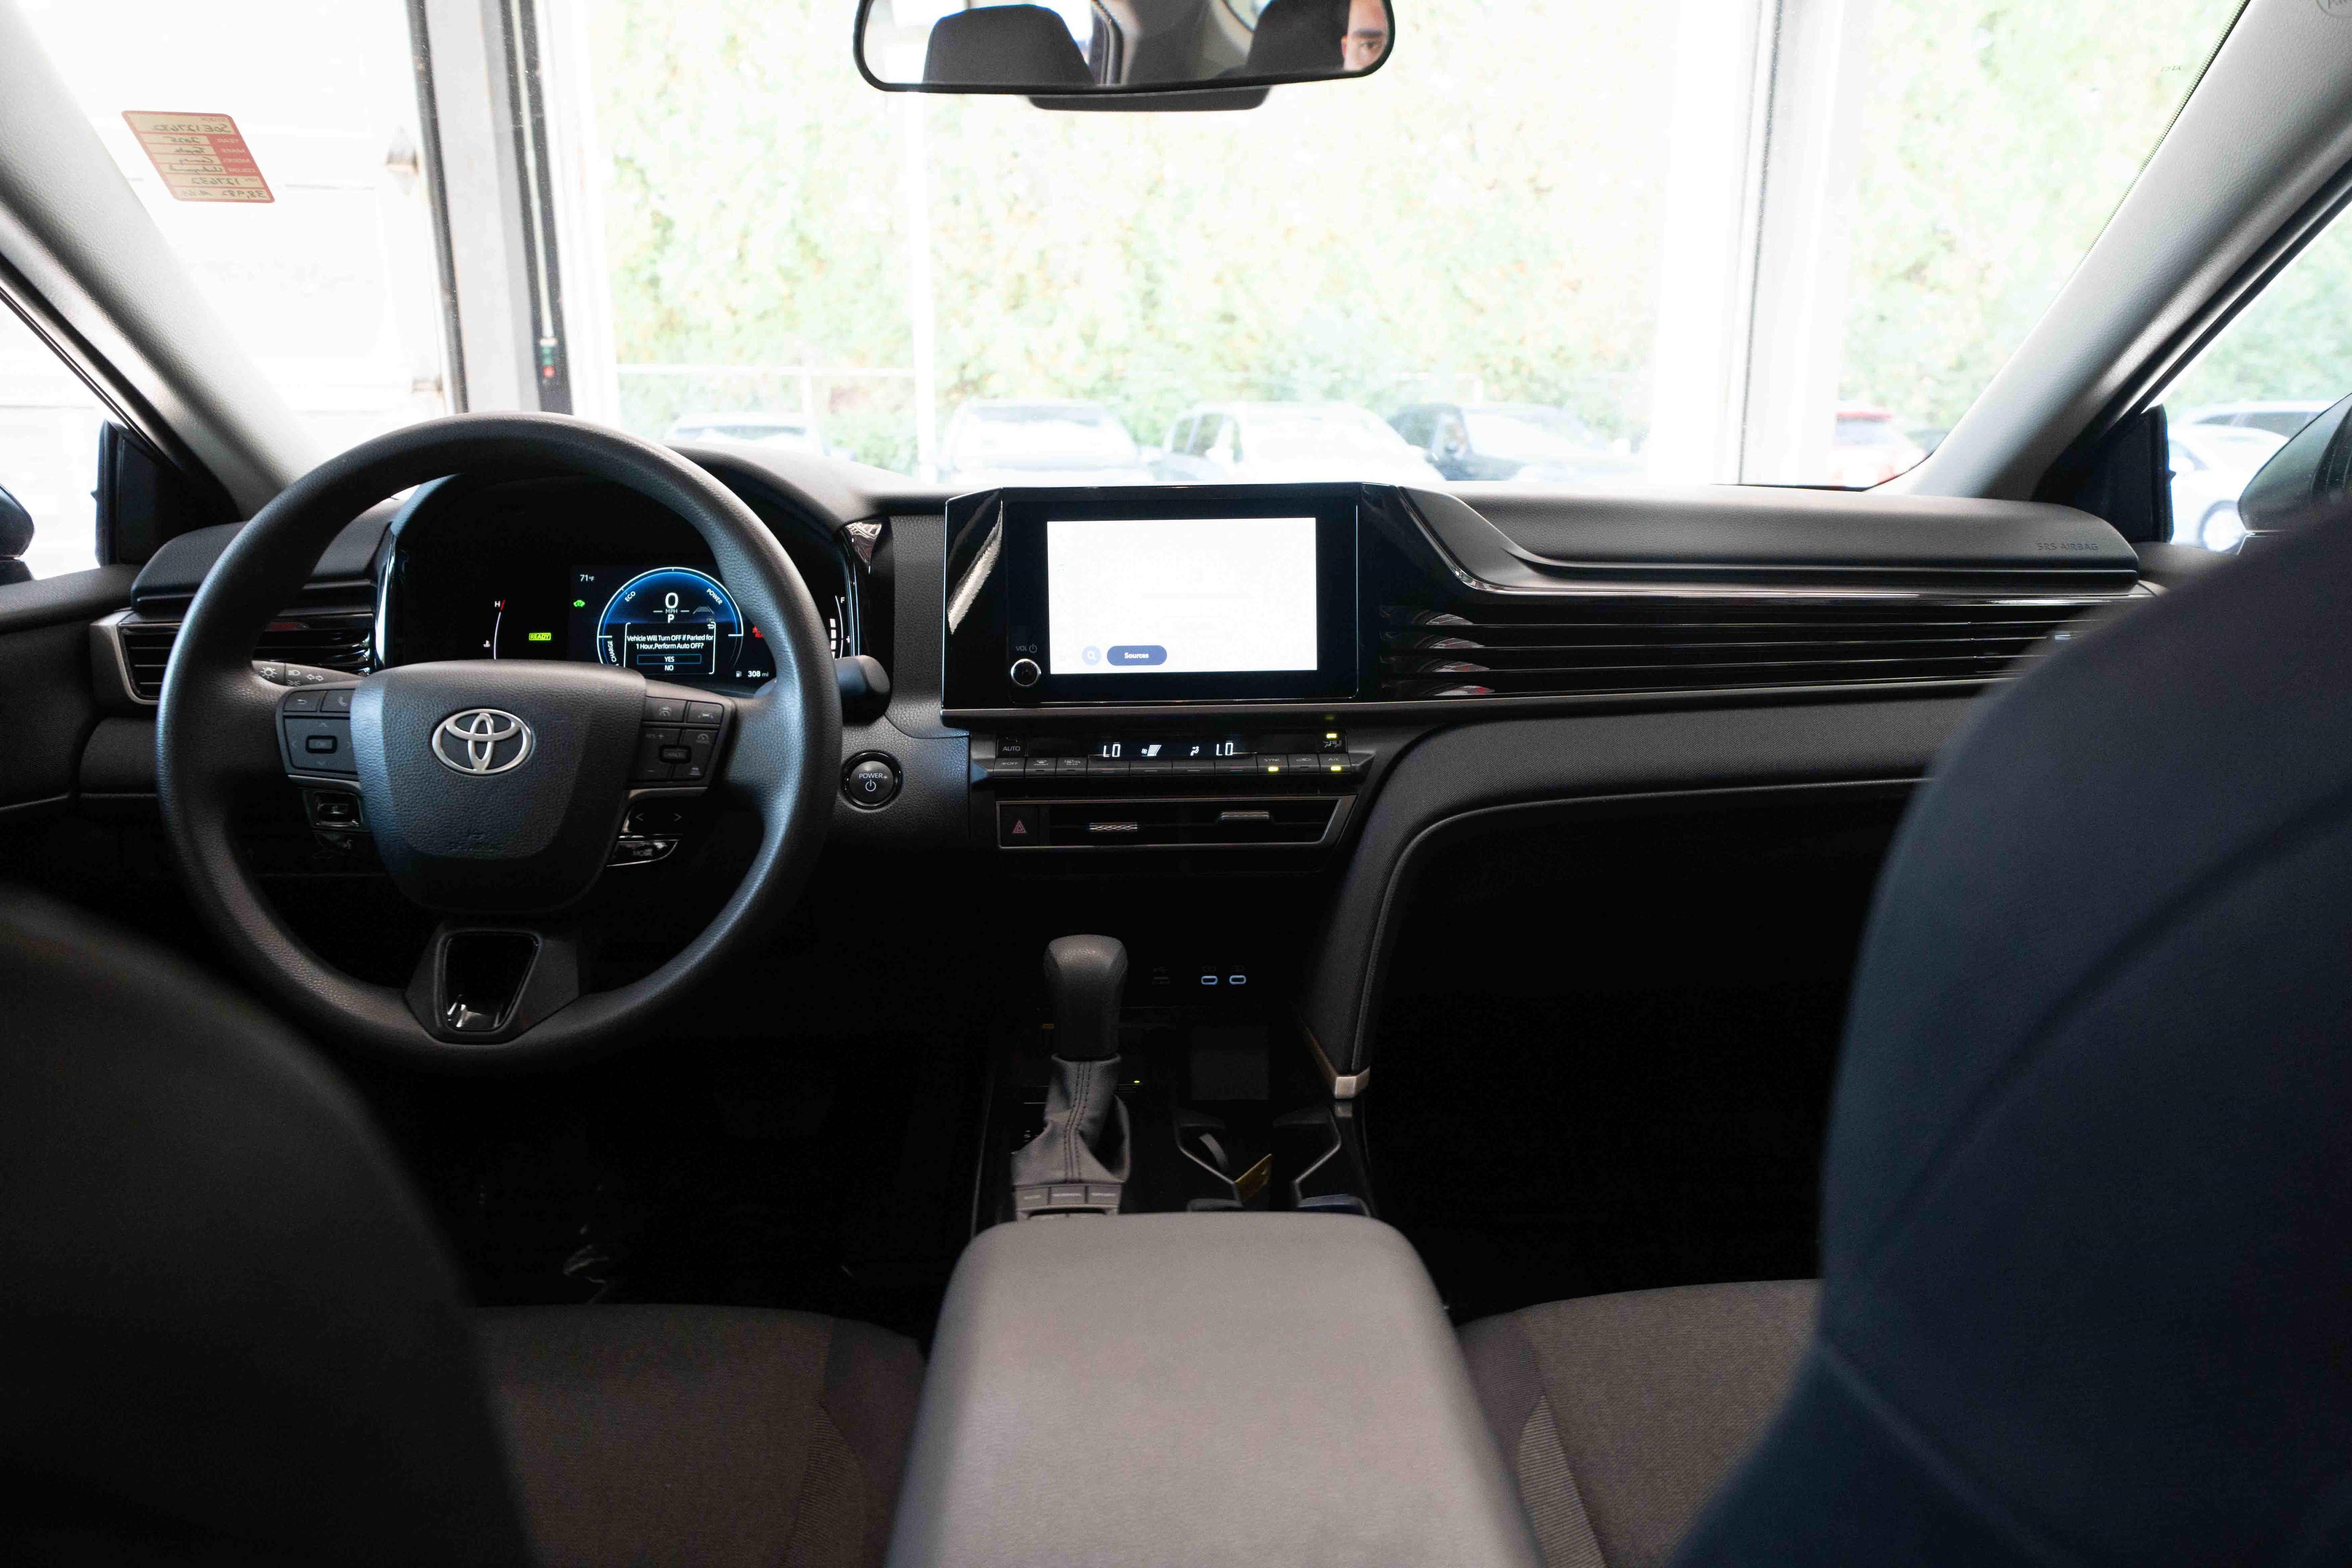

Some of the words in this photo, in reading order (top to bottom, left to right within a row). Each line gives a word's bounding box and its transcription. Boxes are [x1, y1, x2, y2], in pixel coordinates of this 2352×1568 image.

[625, 591, 636, 602] ECO
[665, 592, 679, 609] 0
[706, 588, 723, 605] POWER
[668, 614, 674, 624] P
[607, 640, 617, 662] CHARGE
[1103, 743, 1121, 757] LO
[1216, 742, 1234, 756] LO
